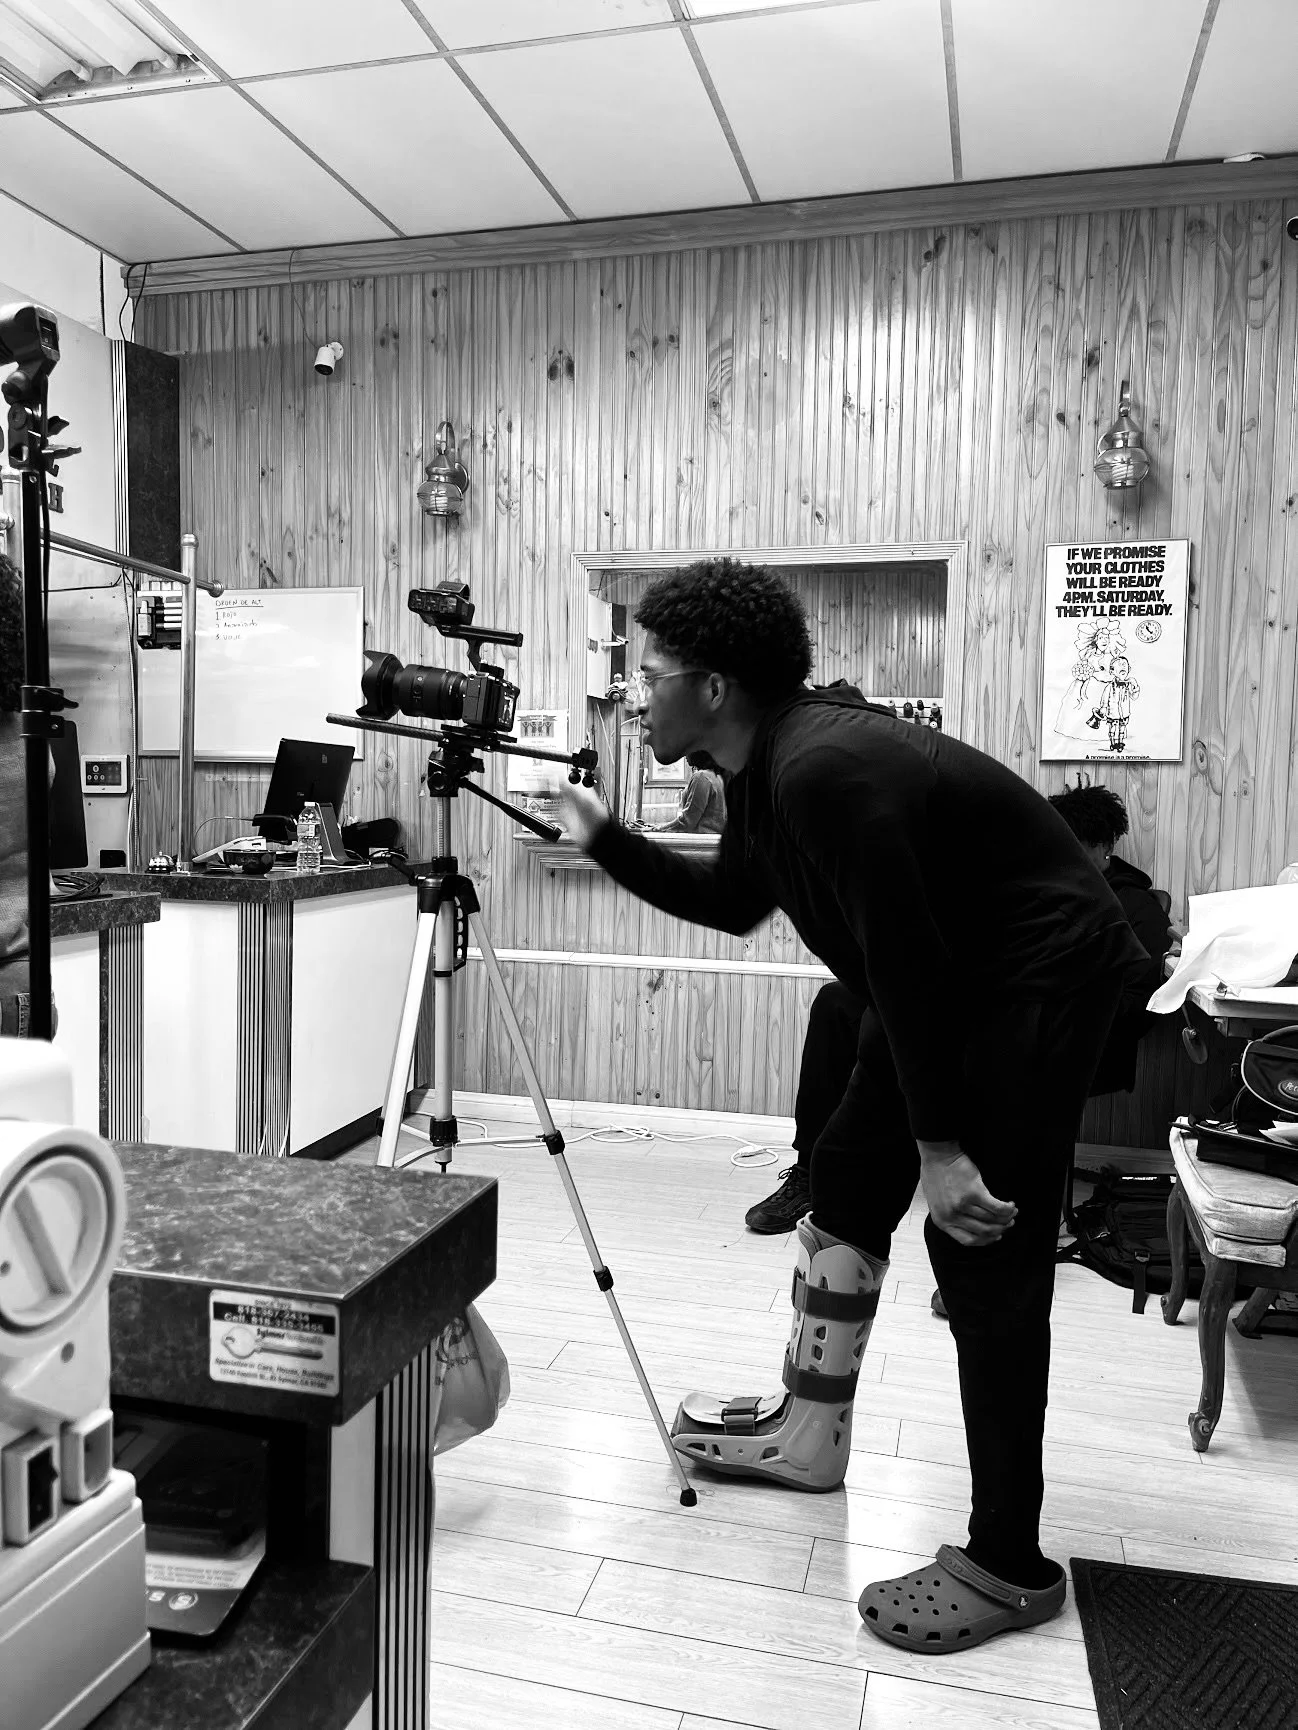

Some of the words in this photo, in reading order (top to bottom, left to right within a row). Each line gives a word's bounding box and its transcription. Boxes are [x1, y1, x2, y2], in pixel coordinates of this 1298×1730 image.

[1067, 548, 1079, 560] IF
[1080, 547, 1102, 560] WE
[1103, 545, 1166, 560] PROMISE
[1066, 561, 1102, 575] YOUR
[1104, 560, 1165, 574] CLOTHES
[1066, 576, 1098, 589] WILL
[1099, 576, 1117, 588] BE
[1118, 575, 1163, 588] READY
[1096, 590, 1165, 604] SATURDAY,
[1055, 605, 1108, 618] THEY'LL
[1108, 604, 1126, 617] BE
[1127, 603, 1173, 617] READY.
